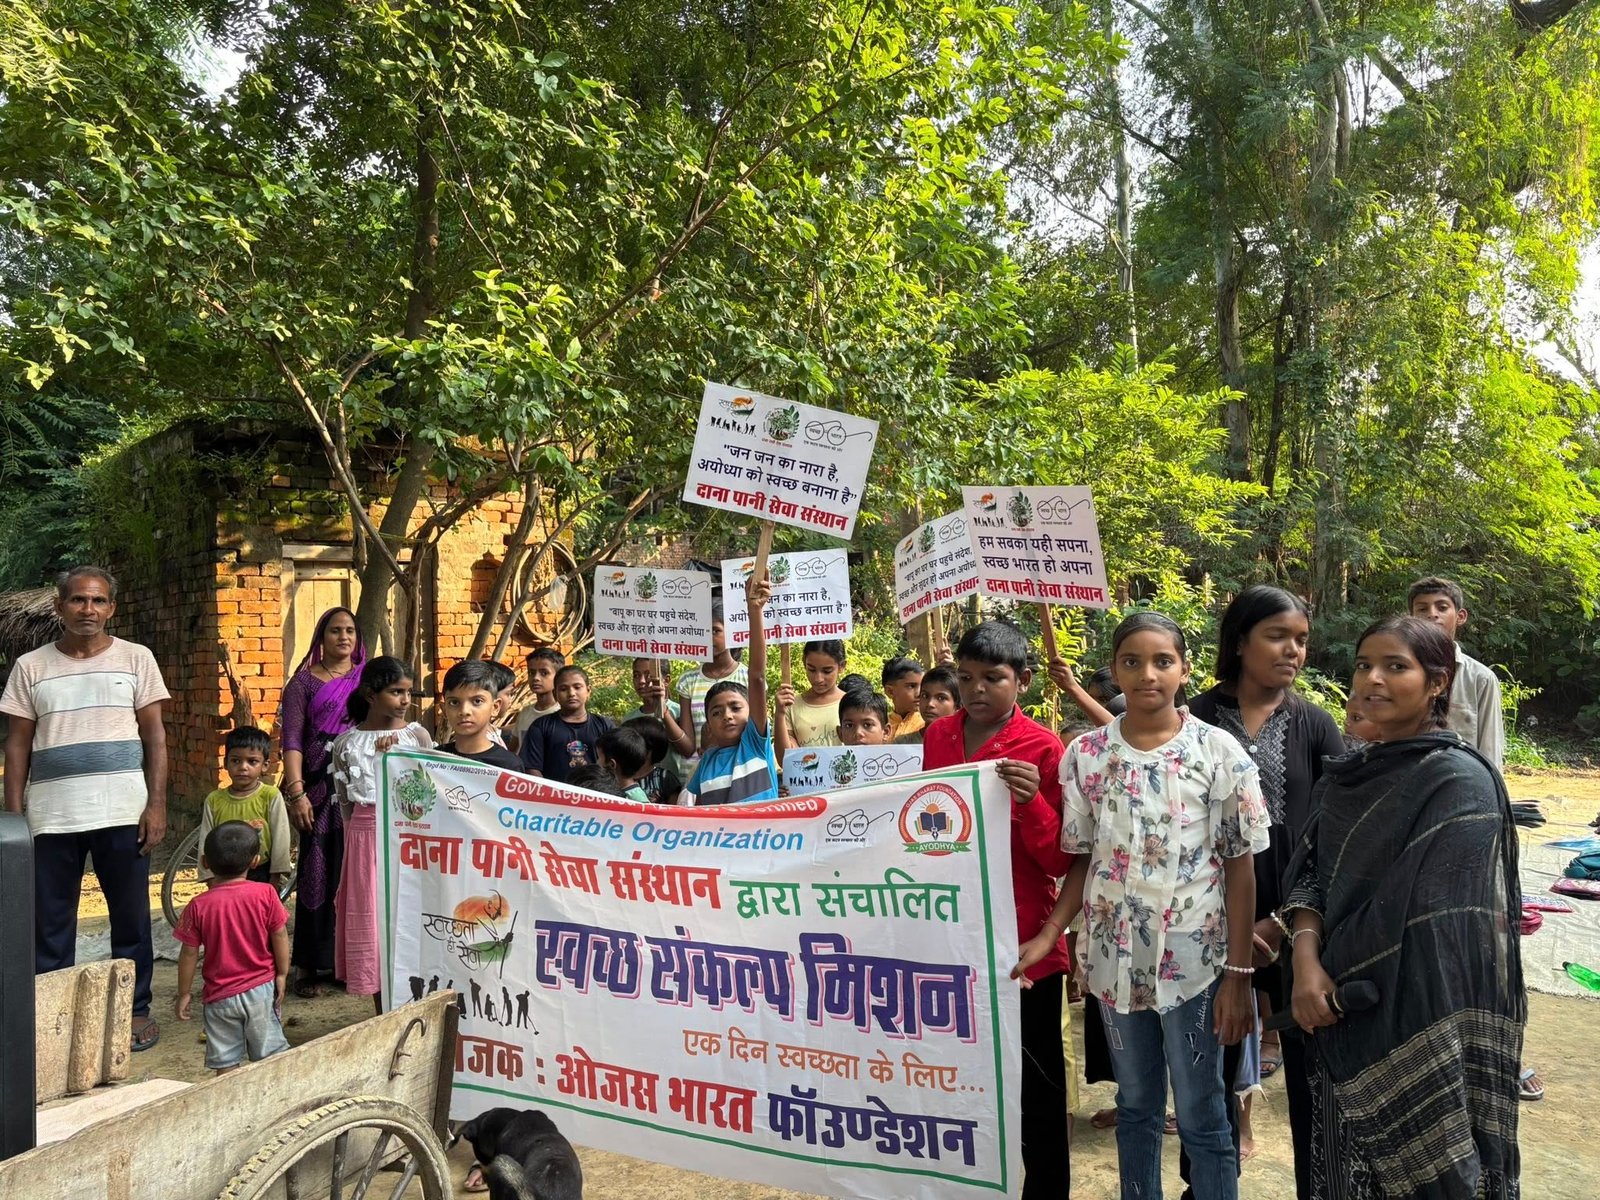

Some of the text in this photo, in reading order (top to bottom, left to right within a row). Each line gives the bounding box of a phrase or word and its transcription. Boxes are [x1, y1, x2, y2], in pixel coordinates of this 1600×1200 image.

[754, 451, 775, 467] जन
[778, 456, 795, 471] का
[799, 461, 826, 477] नारा
[828, 463, 839, 483] है,
[697, 458, 743, 478] अयोध्या
[746, 465, 764, 482] को
[766, 473, 799, 491] स्वच्छ
[802, 481, 839, 501] बनाना
[696, 482, 848, 531] दाना पानी सेवा संस्थान
[978, 535, 994, 548] हम
[997, 537, 1028, 551] सबका
[1030, 536, 1052, 553] यही
[1056, 537, 1093, 556] सपना,
[929, 560, 937, 568] घर
[930, 572, 937, 584] हो
[938, 568, 956, 580] अपना
[959, 560, 976, 573] अयोध्य
[982, 556, 1093, 575] स्वच्छ भारत हो अपना
[799, 592, 818, 602] नारा
[820, 587, 831, 600] है,
[986, 578, 1103, 602] दाना पानी सेवा संस्थान
[625, 610, 635, 618] का
[637, 610, 646, 618] घर
[764, 607, 775, 619] को
[778, 605, 802, 617] स्वच्छ
[804, 605, 833, 616] बनाना
[902, 601, 916, 617] दाना
[917, 592, 932, 608] पानी
[934, 588, 952, 601] सेवा
[598, 622, 615, 631] स्वच्छ
[617, 621, 629, 632] और
[631, 623, 646, 635] सुंदर
[648, 623, 655, 633] हो
[679, 625, 705, 637] अयोध्या
[784, 623, 807, 638] सेवा
[810, 621, 847, 635] संस्थान
[602, 639, 708, 656] दाना पानी सेवा संस्थान
[504, 776, 545, 797] Govt.
[917, 785, 936, 797] BHARAT
[937, 785, 963, 806] FOUNDATION
[498, 806, 804, 851] Charitable Organization
[919, 843, 956, 851] AYODHYA
[399, 833, 961, 923] दाना पानी सेवा संस्थान द्वारा संचालित
[421, 912, 479, 940] स्वच्छता
[456, 943, 482, 970] सेवा
[534, 919, 977, 1044] स्वच्छ संकल्प मिशन
[683, 1029, 722, 1056] एक
[728, 1026, 769, 1064] दिन
[776, 1043, 860, 1081] स्वच्छता
[868, 1048, 894, 1083] के
[555, 1045, 659, 1114] ओजस
[668, 1076, 757, 1134] भारत
[768, 1084, 978, 1167] फॉउण्डेशन
